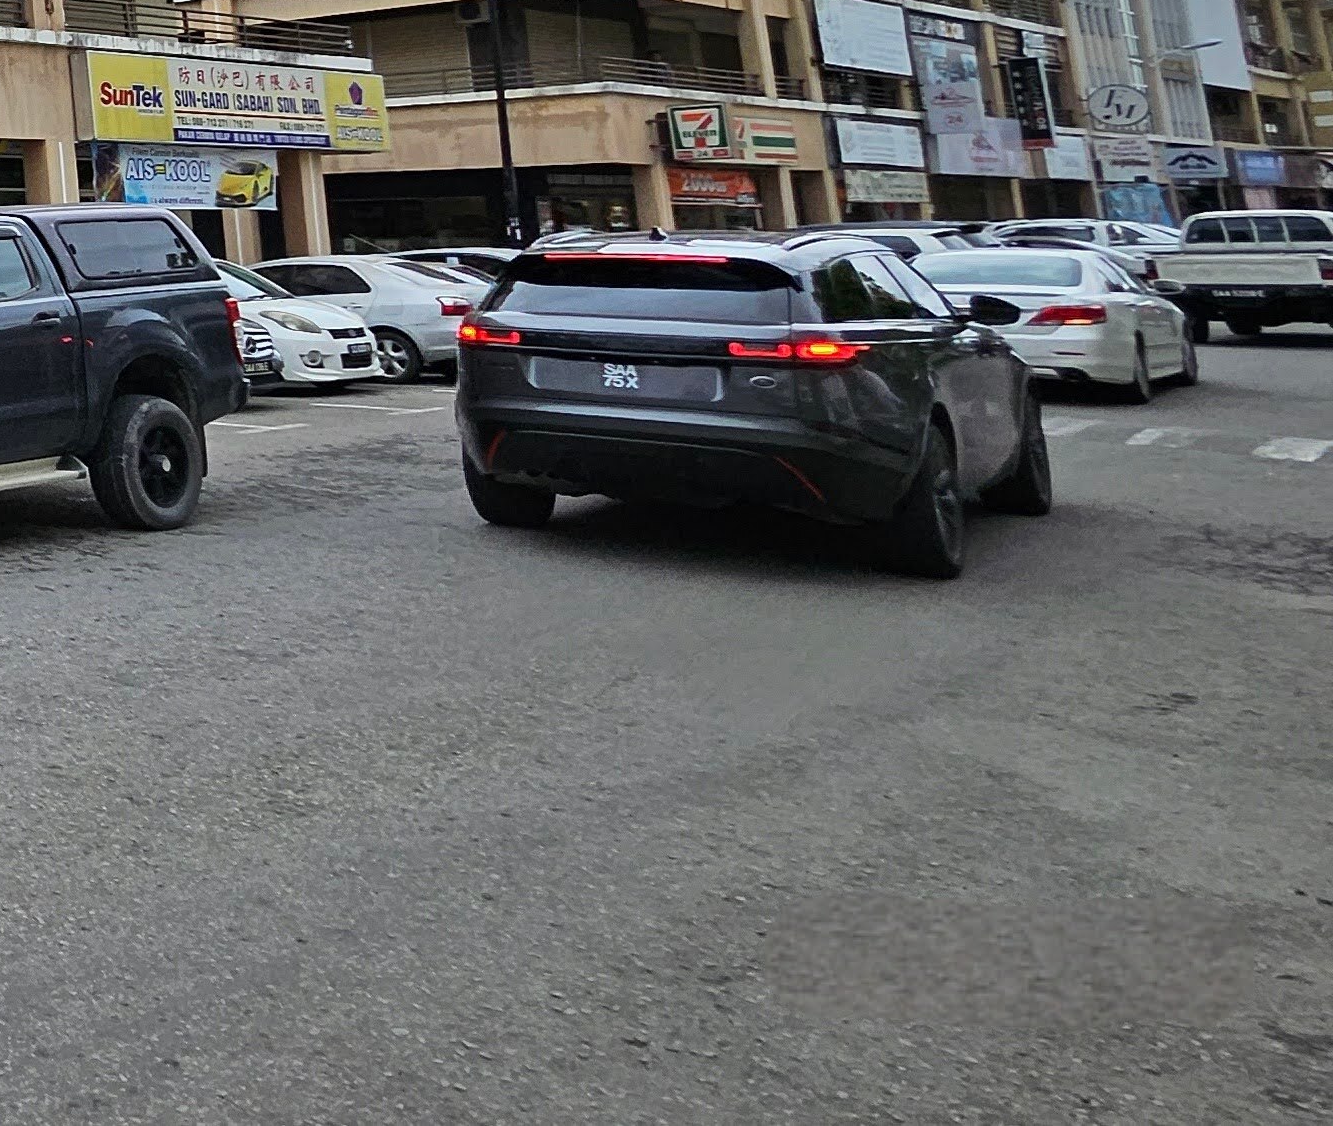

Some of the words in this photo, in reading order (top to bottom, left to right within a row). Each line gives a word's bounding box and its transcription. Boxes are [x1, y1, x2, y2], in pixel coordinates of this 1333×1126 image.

[100, 81, 164, 108] SunTek
[174, 89, 230, 110] SUN-GARD
[233, 93, 274, 113] (SABAH)
[277, 96, 300, 114] SDN.
[302, 98, 323, 115] BHD.
[603, 362, 638, 376] SAA
